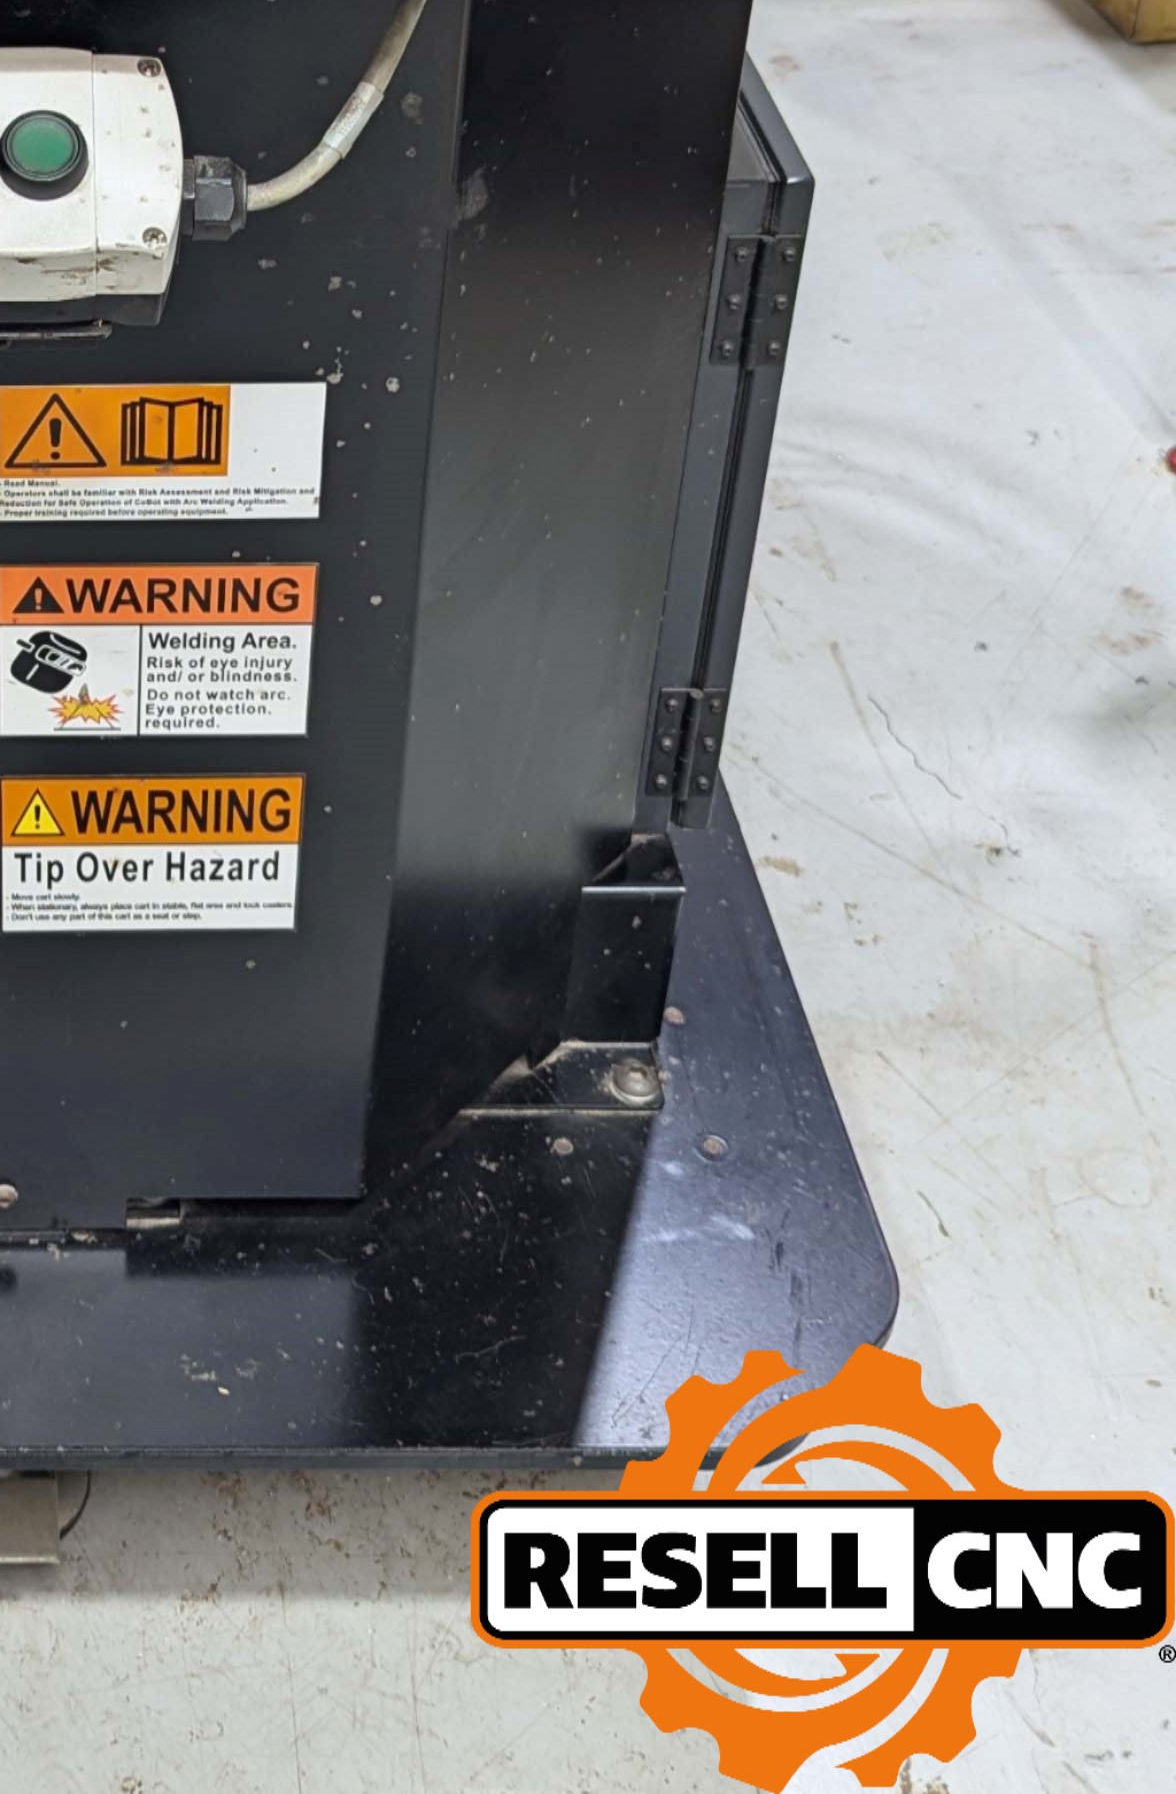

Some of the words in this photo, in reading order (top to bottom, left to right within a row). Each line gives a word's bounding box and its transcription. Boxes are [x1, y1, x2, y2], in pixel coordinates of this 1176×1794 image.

[4, 489, 46, 498] Operators
[49, 488, 69, 497] shall
[71, 488, 81, 496] be
[84, 488, 116, 496] familiar
[119, 488, 137, 496] with
[139, 488, 157, 496] Risk
[160, 487, 212, 495] Assessment
[214, 487, 230, 495] and
[233, 487, 251, 495] Risk
[254, 487, 297, 496] Mitigation
[0, 499, 41, 507] Reduction
[79, 498, 121, 508] Operation
[124, 498, 133, 506] of
[164, 497, 181, 505] with
[183, 497, 198, 505] Arc
[201, 497, 235, 506] Welding
[237, 497, 288, 507] Application.
[4, 509, 32, 518] Proper
[35, 509, 68, 517] training
[70, 508, 105, 517] required
[108, 508, 135, 516] before
[138, 508, 178, 517] operating
[180, 507, 228, 516] equipment.
[65, 577, 300, 614] WARNING
[149, 632, 235, 653] Welding
[241, 632, 297, 649] Area.
[147, 656, 183, 668] Risk
[189, 656, 205, 668] of
[210, 658, 239, 670] eye
[244, 656, 293, 671] injury
[147, 671, 183, 682] and/
[188, 672, 205, 682] or
[210, 670, 297, 682] blindness.
[147, 689, 169, 701] Do
[175, 689, 201, 701] not
[206, 689, 255, 701] watch
[260, 690, 291, 701] arc.
[145, 704, 175, 717] Eye
[180, 703, 272, 717] protection.
[145, 716, 220, 730] required.
[71, 788, 291, 834] WARNING
[14, 853, 64, 889] Tip
[76, 852, 154, 882] Over
[166, 851, 280, 881] Hazard
[80, 902, 108, 911] always
[110, 902, 132, 911] place
[134, 902, 149, 910] cart
[69, 913, 85, 921] part
[87, 912, 96, 920] of
[98, 912, 112, 920] this
[115, 912, 130, 920] cart
